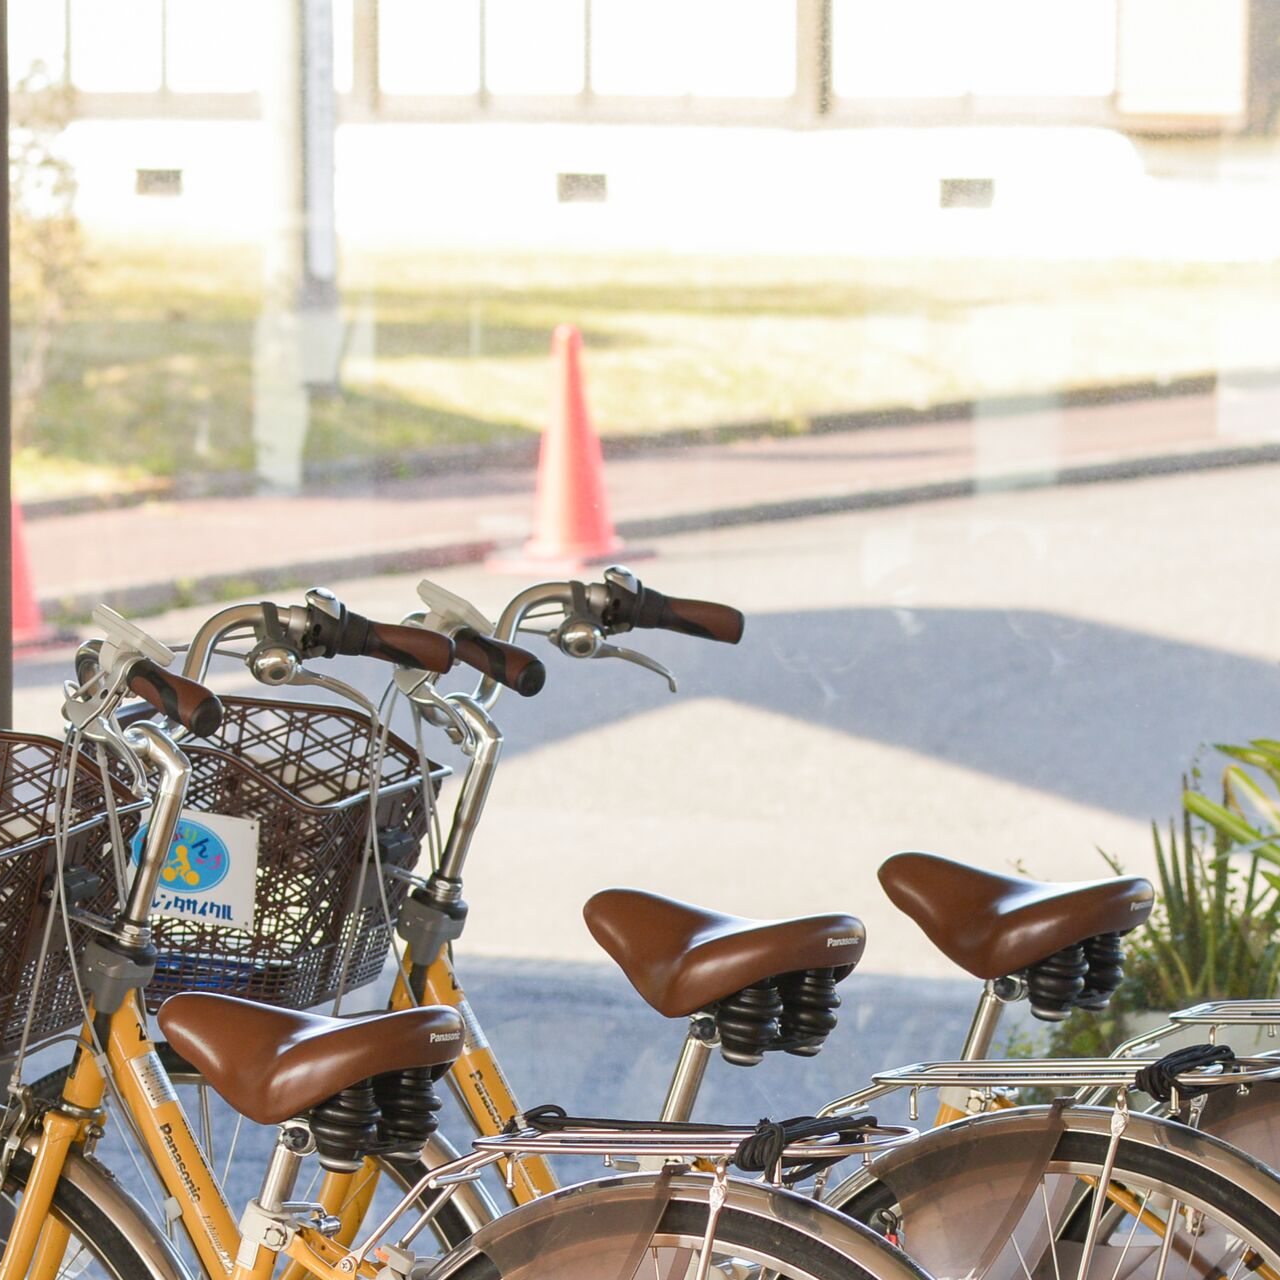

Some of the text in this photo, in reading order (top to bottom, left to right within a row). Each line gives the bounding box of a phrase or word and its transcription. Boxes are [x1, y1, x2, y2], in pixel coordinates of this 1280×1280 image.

[827, 936, 860, 948] Panasonic
[429, 1030, 461, 1044] Panasonic
[160, 1122, 201, 1203] Panasonic
